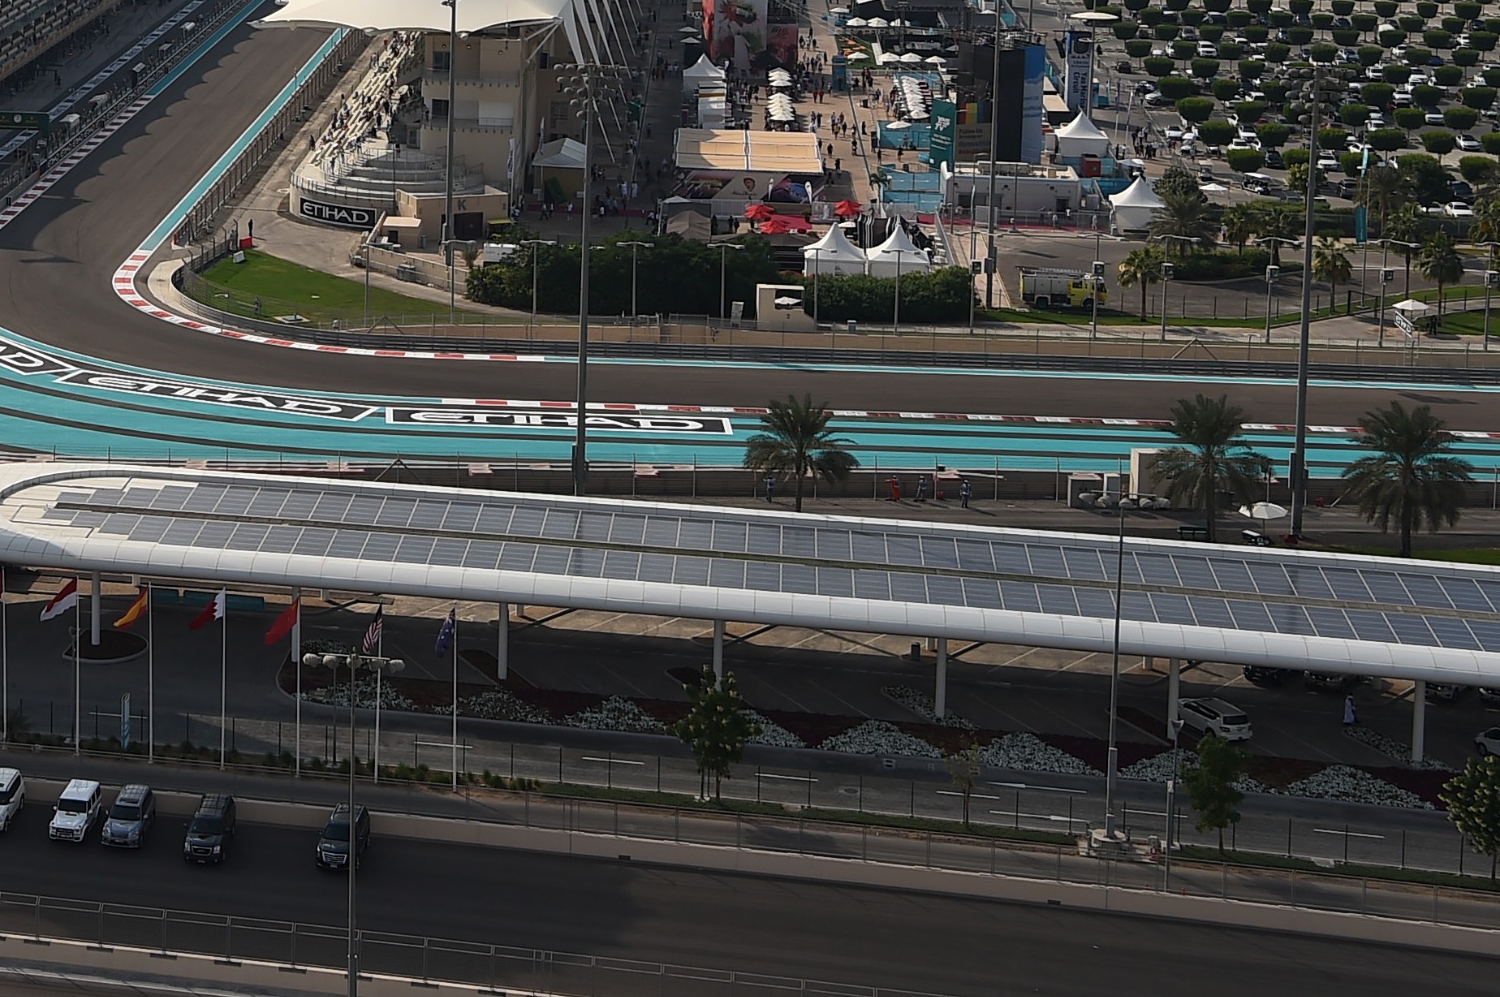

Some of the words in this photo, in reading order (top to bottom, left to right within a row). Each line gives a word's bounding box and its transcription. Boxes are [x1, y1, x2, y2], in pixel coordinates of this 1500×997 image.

[302, 201, 369, 224] ETIHAD
[457, 199, 467, 211] K
[88, 375, 342, 415] ETIHAD
[409, 410, 705, 431] ETIHAD
